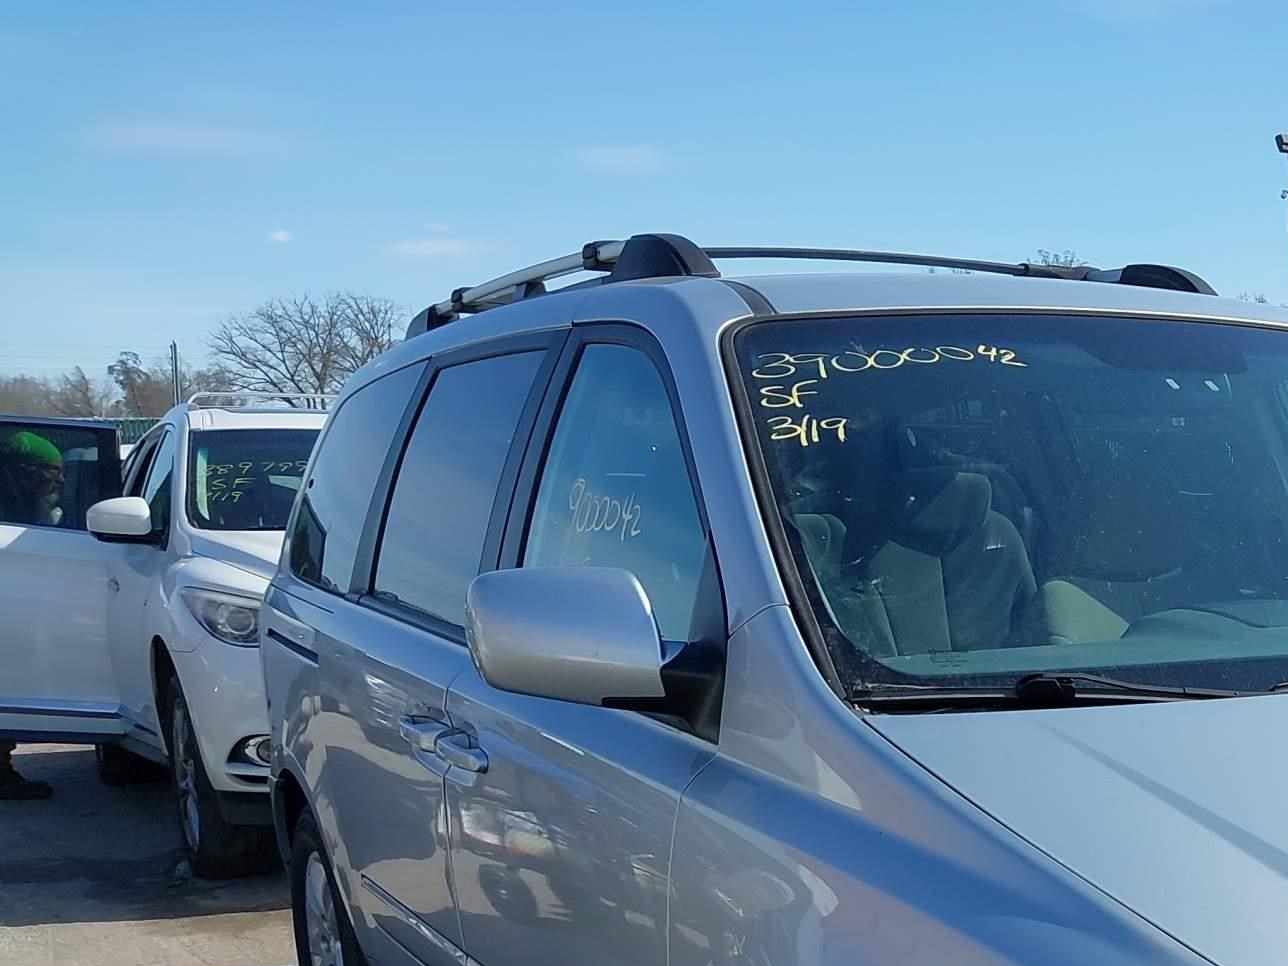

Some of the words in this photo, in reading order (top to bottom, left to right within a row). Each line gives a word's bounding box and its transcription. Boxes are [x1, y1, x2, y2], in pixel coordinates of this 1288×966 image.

[751, 345, 1028, 379] 39000042
[760, 380, 819, 408] SF
[767, 415, 848, 447] 3/19
